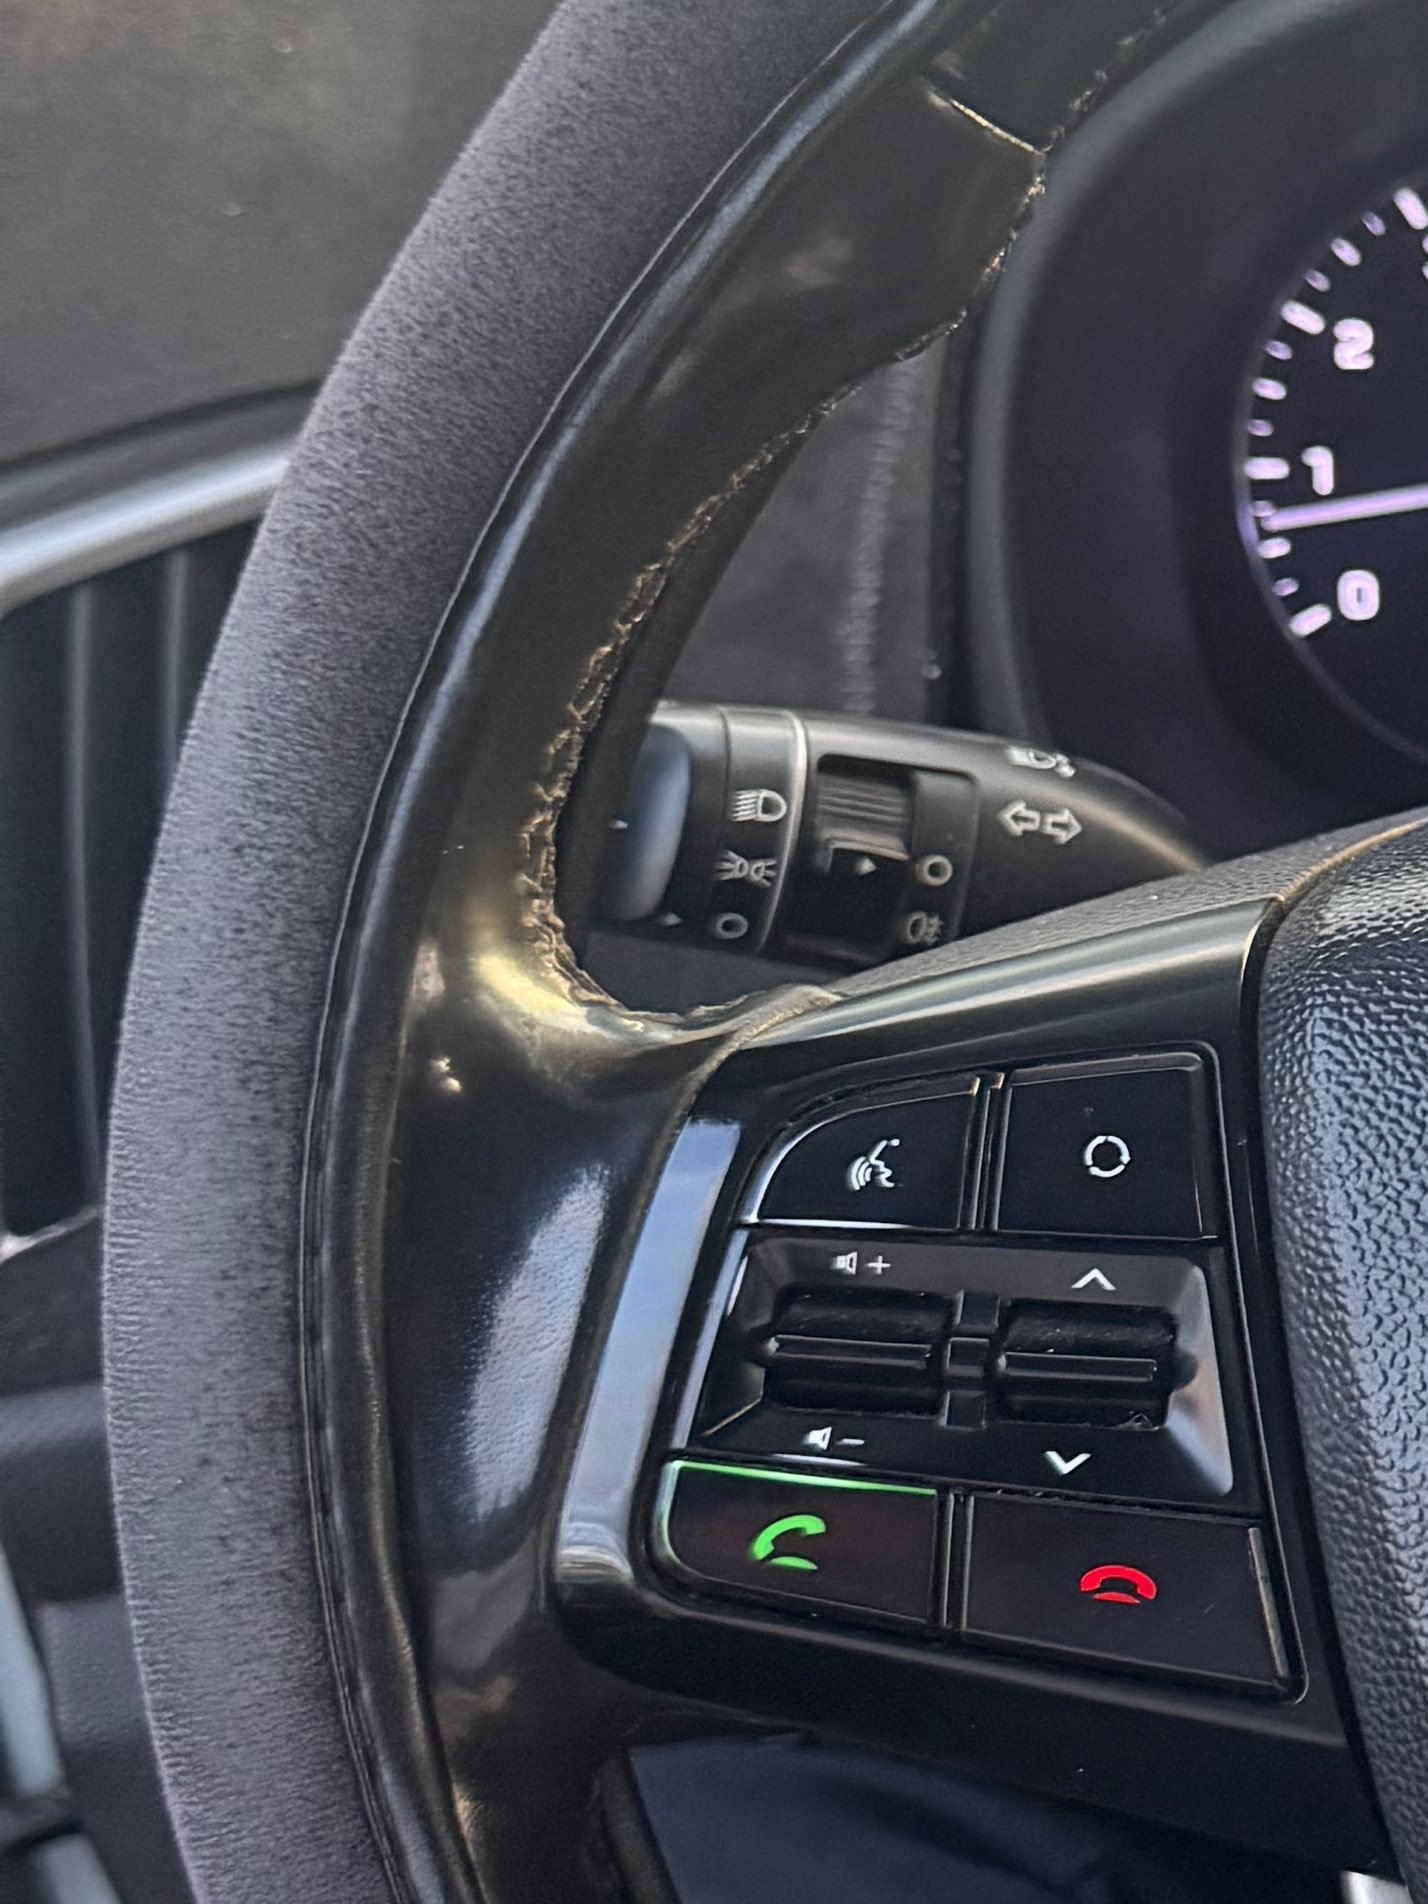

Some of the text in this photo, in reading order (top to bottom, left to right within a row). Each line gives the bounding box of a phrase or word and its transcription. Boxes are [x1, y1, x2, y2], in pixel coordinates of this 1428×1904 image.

[1333, 317, 1374, 370] 2
[1301, 445, 1334, 495] 1
[1336, 569, 1380, 620] 0
